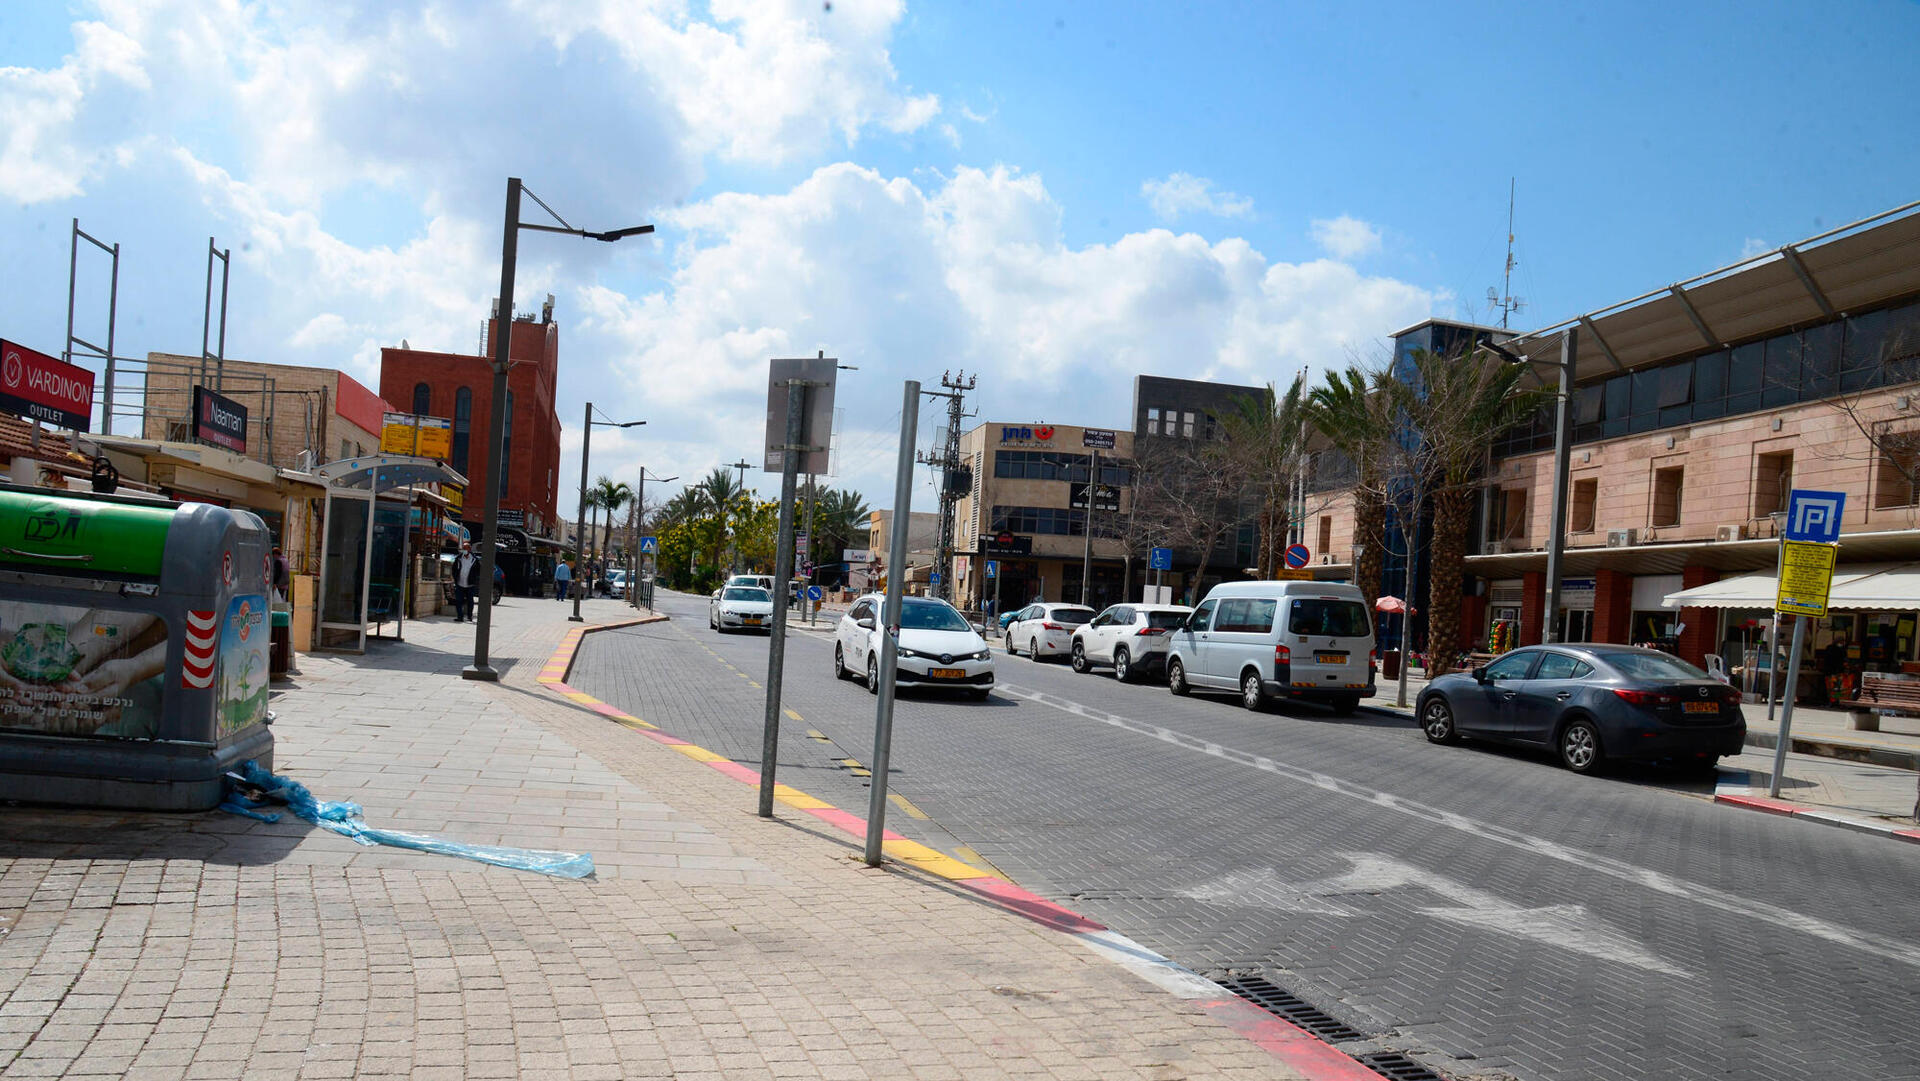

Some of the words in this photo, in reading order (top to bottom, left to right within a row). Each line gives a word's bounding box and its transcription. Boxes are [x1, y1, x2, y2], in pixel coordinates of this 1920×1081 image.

[27, 365, 91, 405] VARDINON
[30, 404, 64, 423] OUTLET
[210, 401, 242, 433] Naaman
[213, 432, 232, 446] OUTLET
[1002, 426, 1031, 442] מתן
[103, 697, 134, 708] נרכש
[59, 707, 104, 720] שומרים
